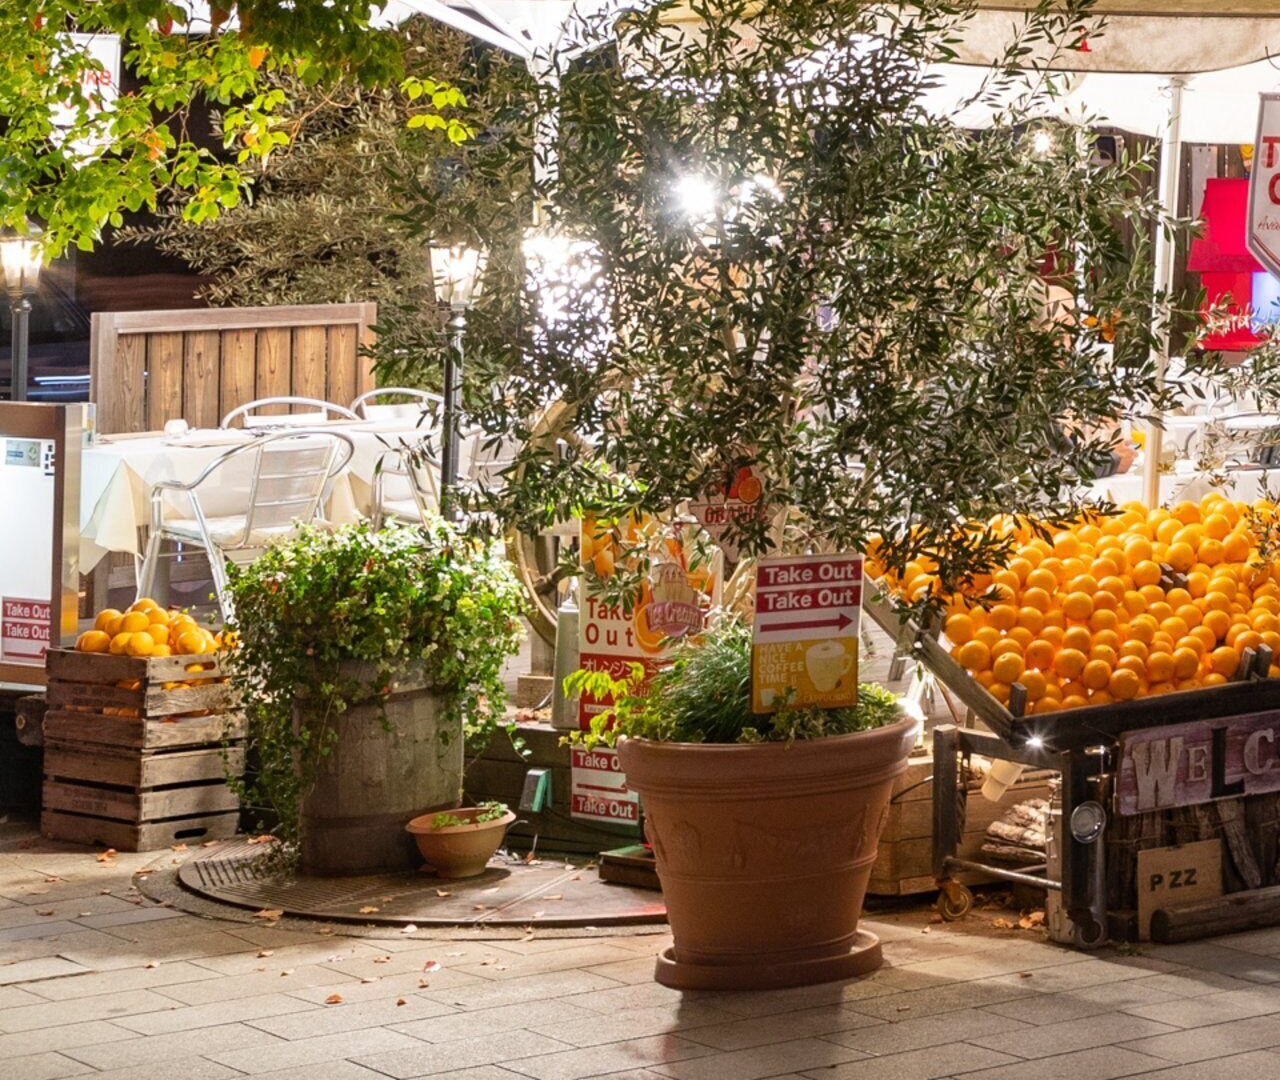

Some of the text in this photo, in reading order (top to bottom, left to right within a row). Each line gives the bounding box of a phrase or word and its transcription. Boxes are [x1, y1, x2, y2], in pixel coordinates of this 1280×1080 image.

[766, 563, 854, 584] Take Out
[764, 589, 853, 610] Take Out
[6, 603, 50, 619] Take Out
[586, 597, 634, 621] Take
[5, 624, 50, 639] Take Out
[586, 623, 634, 647] Out
[759, 643, 793, 653] HAVE
[759, 652, 786, 663] NICE
[759, 661, 805, 674] COFFEE
[759, 672, 787, 683] TIME
[577, 753, 608, 769] Take
[577, 797, 633, 818] Take Out
